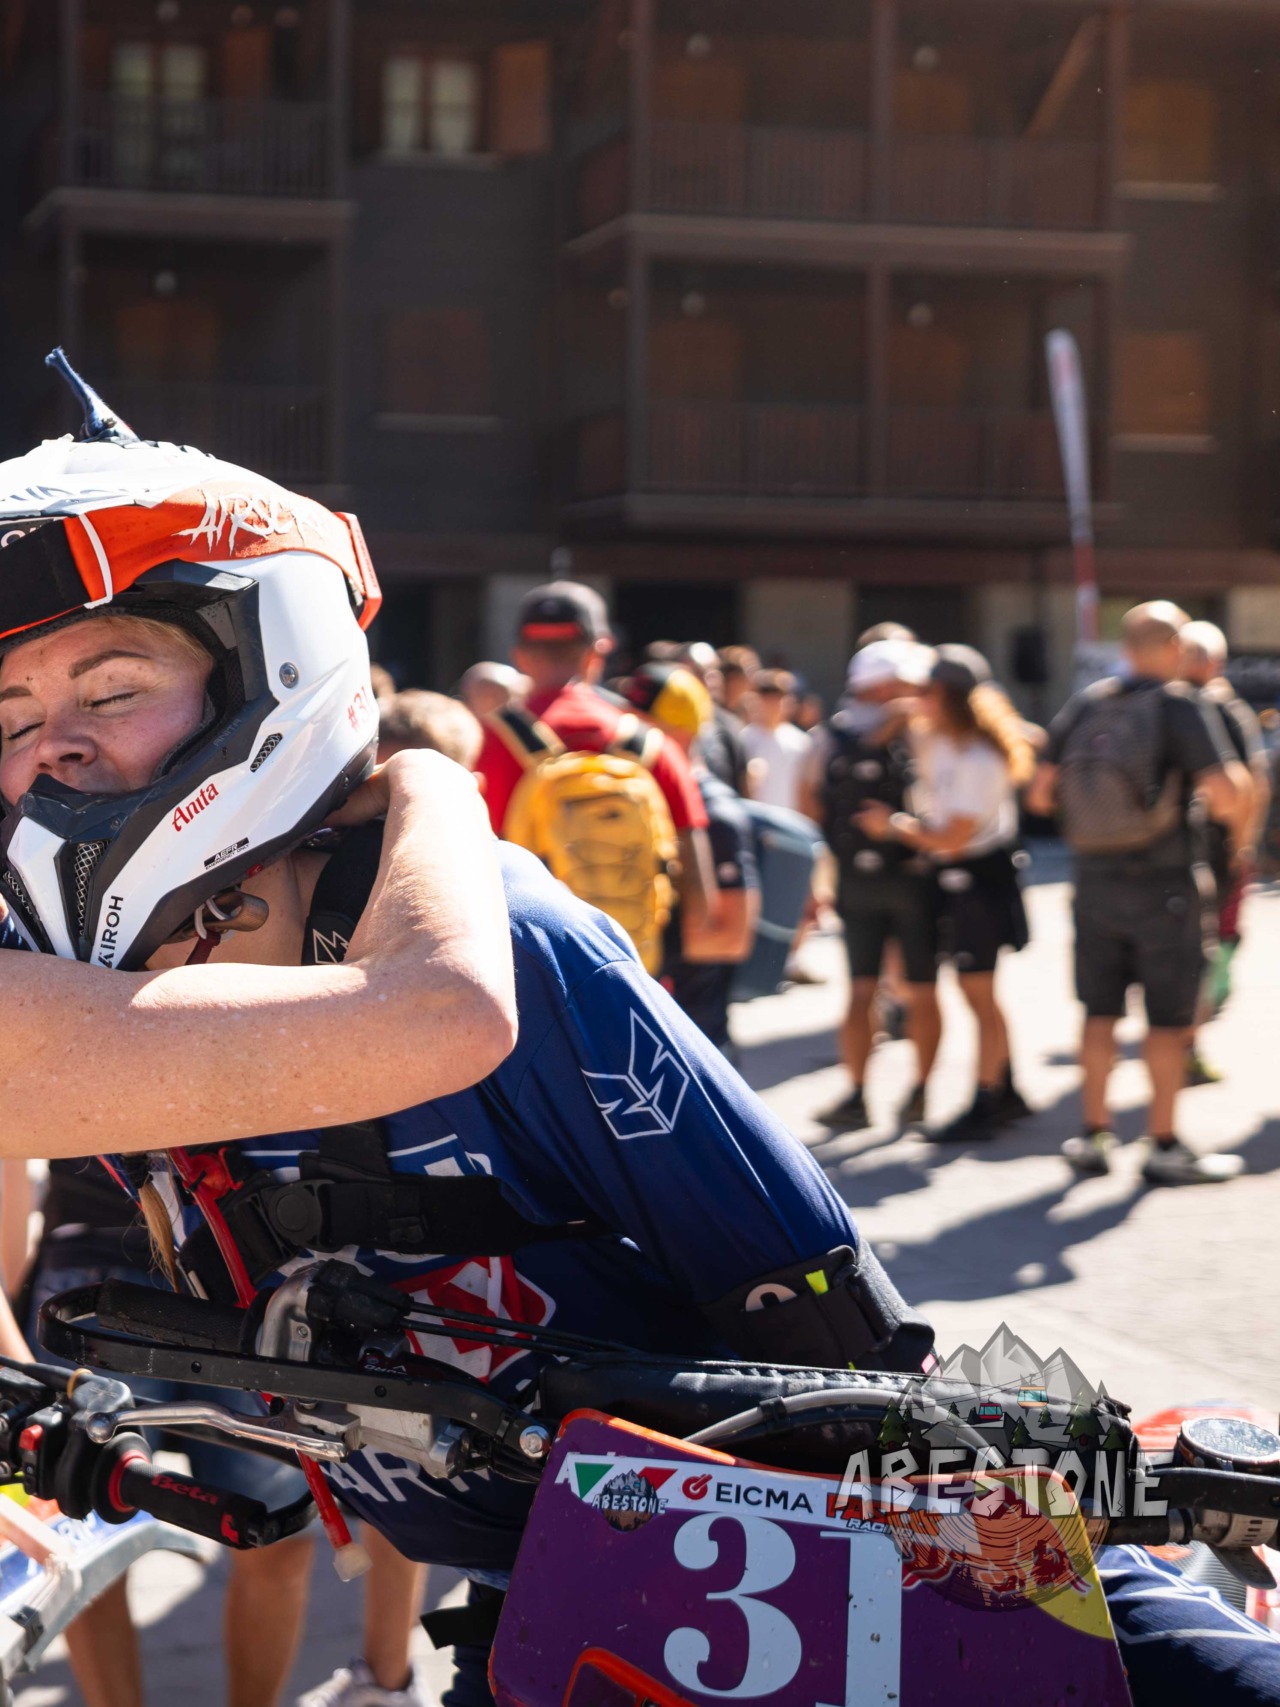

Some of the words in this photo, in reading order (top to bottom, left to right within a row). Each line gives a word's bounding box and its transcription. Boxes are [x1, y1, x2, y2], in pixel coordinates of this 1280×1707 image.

[171, 783, 220, 832] Anita
[98, 895, 124, 969] AIROH
[152, 1473, 219, 1505] Beta
[592, 1493, 669, 1515] ABESTONE
[715, 1482, 814, 1514] EICMA
[663, 1511, 902, 1707] 31
